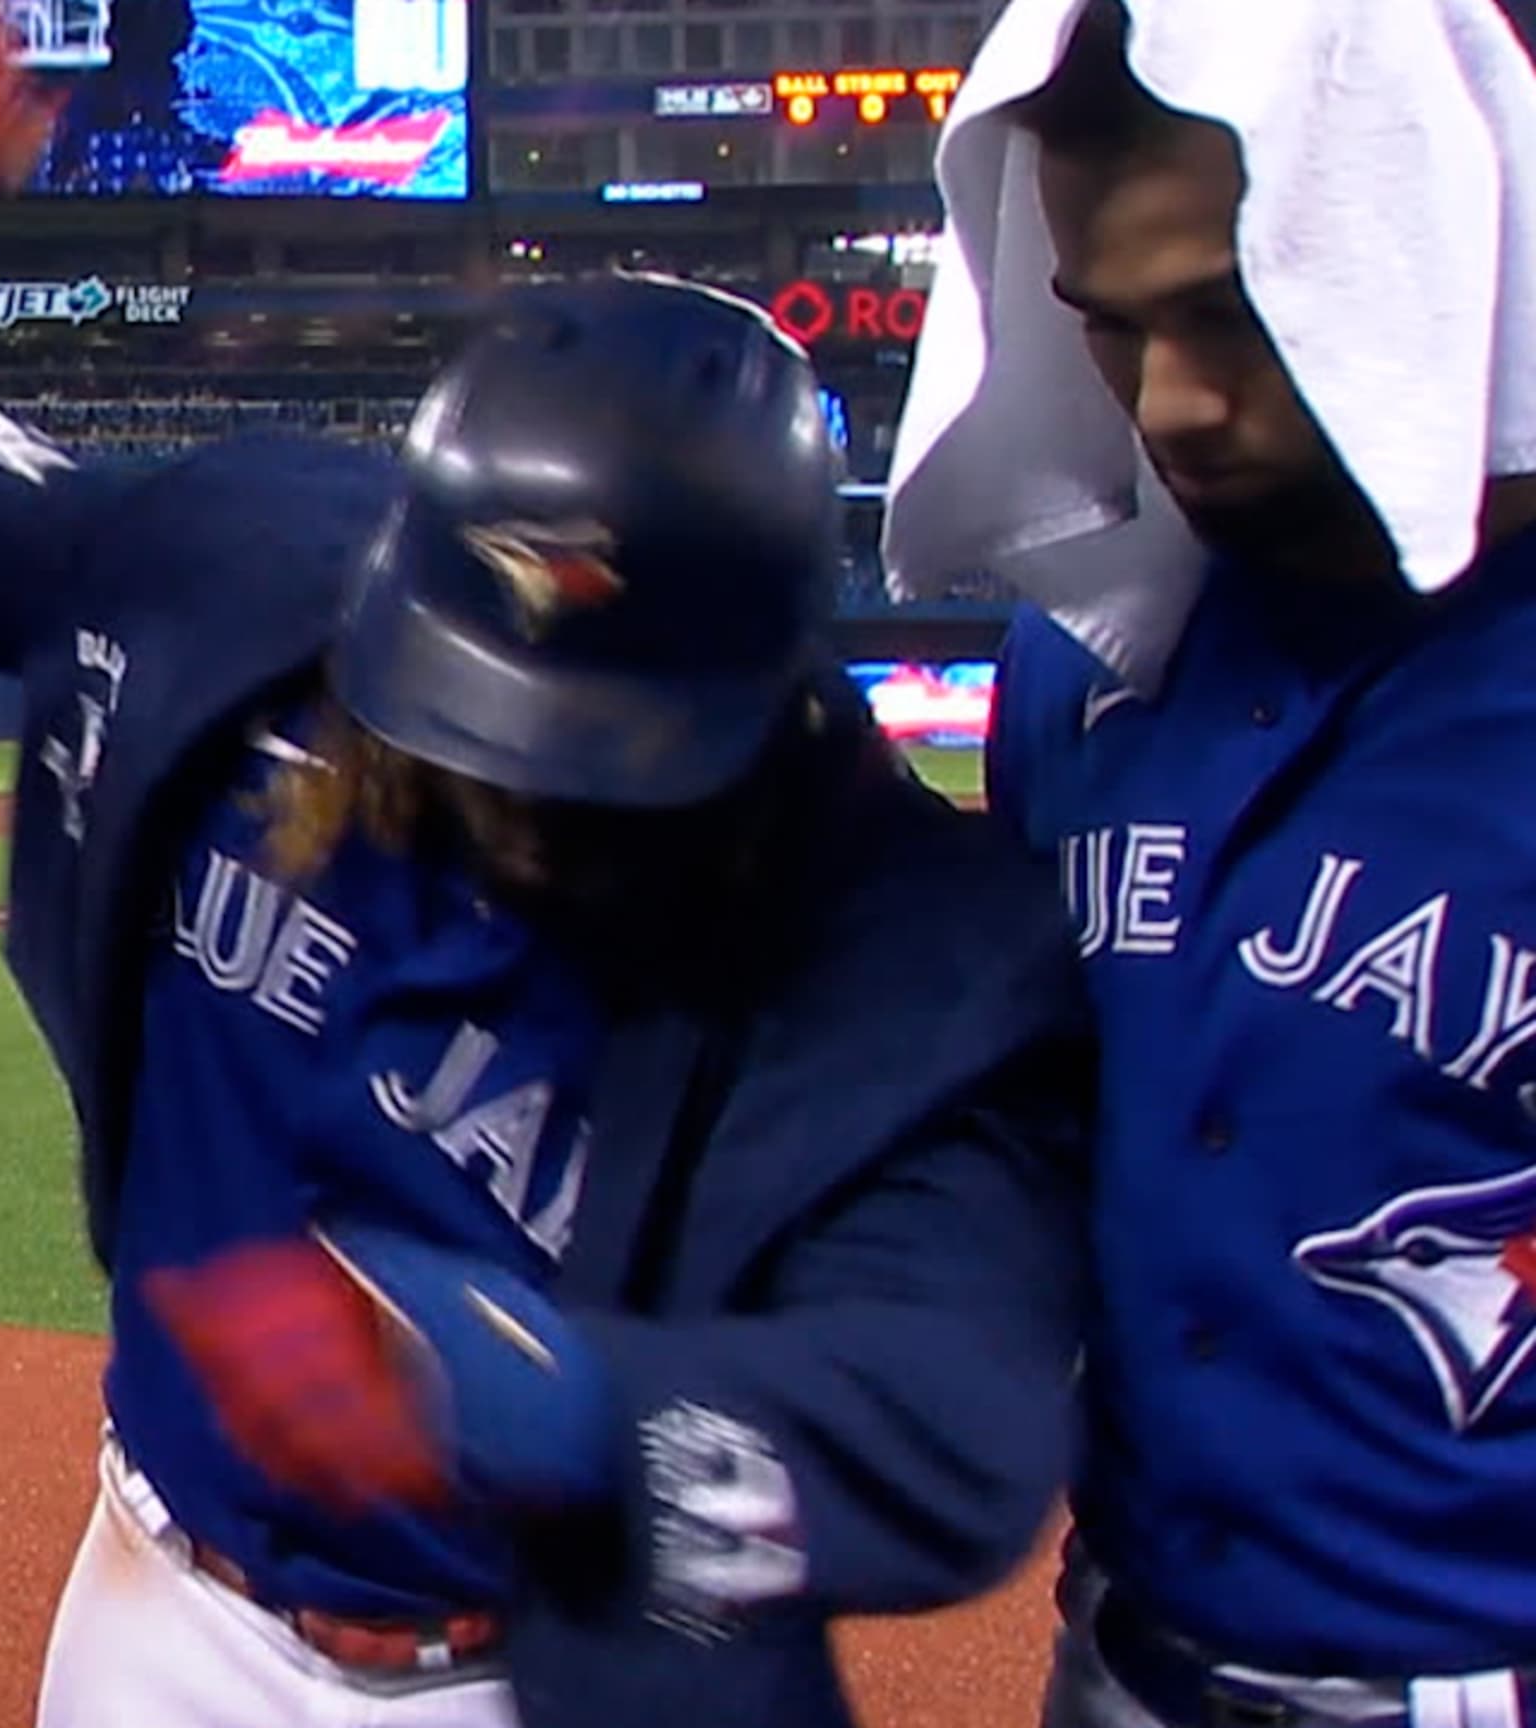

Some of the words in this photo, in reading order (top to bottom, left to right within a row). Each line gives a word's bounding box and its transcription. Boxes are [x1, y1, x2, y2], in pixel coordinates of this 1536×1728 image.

[776, 74, 828, 95] BALL
[835, 72, 906, 94] STRIKE
[916, 71, 960, 92] OUT
[789, 97, 813, 123] 0
[861, 95, 885, 122] 0
[116, 285, 190, 304] FLIGHT
[125, 303, 181, 323] DECK
[1237, 853, 1536, 1113] JAY
